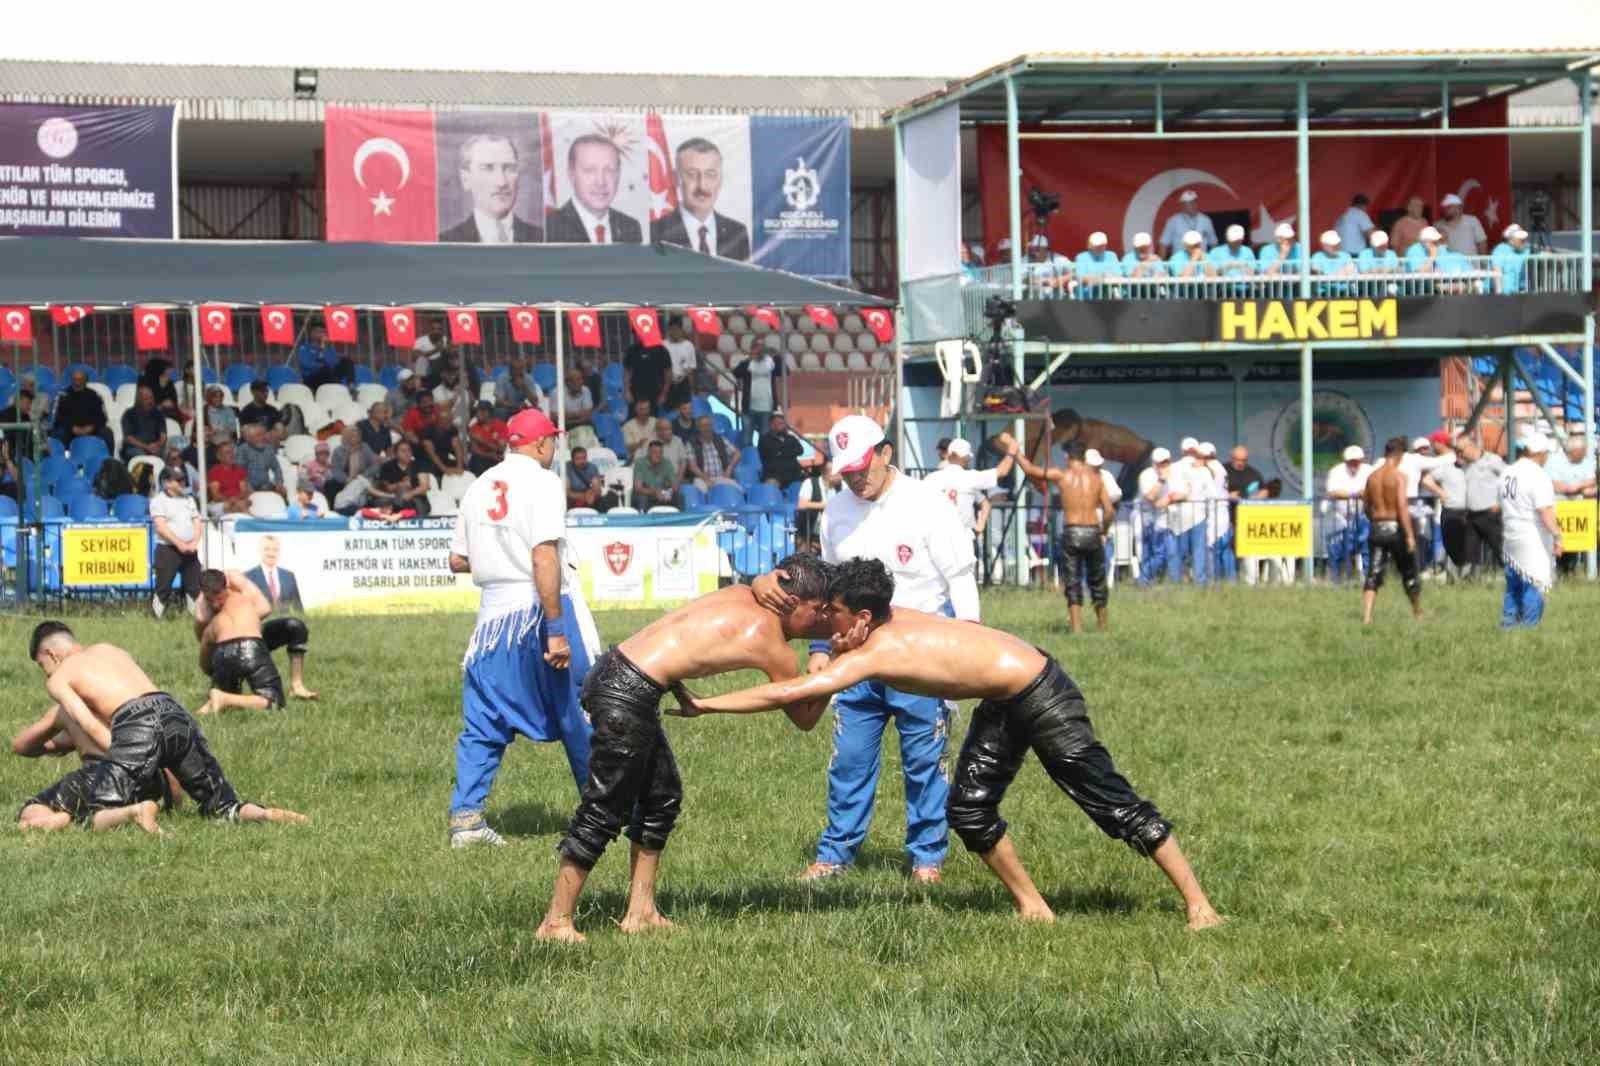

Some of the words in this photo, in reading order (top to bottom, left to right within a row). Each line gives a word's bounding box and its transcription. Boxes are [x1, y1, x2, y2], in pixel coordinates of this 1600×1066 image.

[42, 163, 72, 183] TÜM
[30, 188, 47, 206] VE
[1221, 297, 1398, 341] HAKEM
[1503, 475, 1518, 500] 30
[487, 479, 509, 522] 3
[1247, 522, 1303, 539] HAKEM
[1555, 517, 1589, 533] KEM
[80, 535, 132, 553] SEYİRCİ
[345, 537, 388, 551] KATILAN
[418, 537, 453, 550] SPORC
[78, 558, 135, 576] TRİBÜNÜ
[322, 555, 378, 571] ANTRENÖR
[381, 557, 394, 570] VE
[399, 557, 449, 570] HAKEMLE
